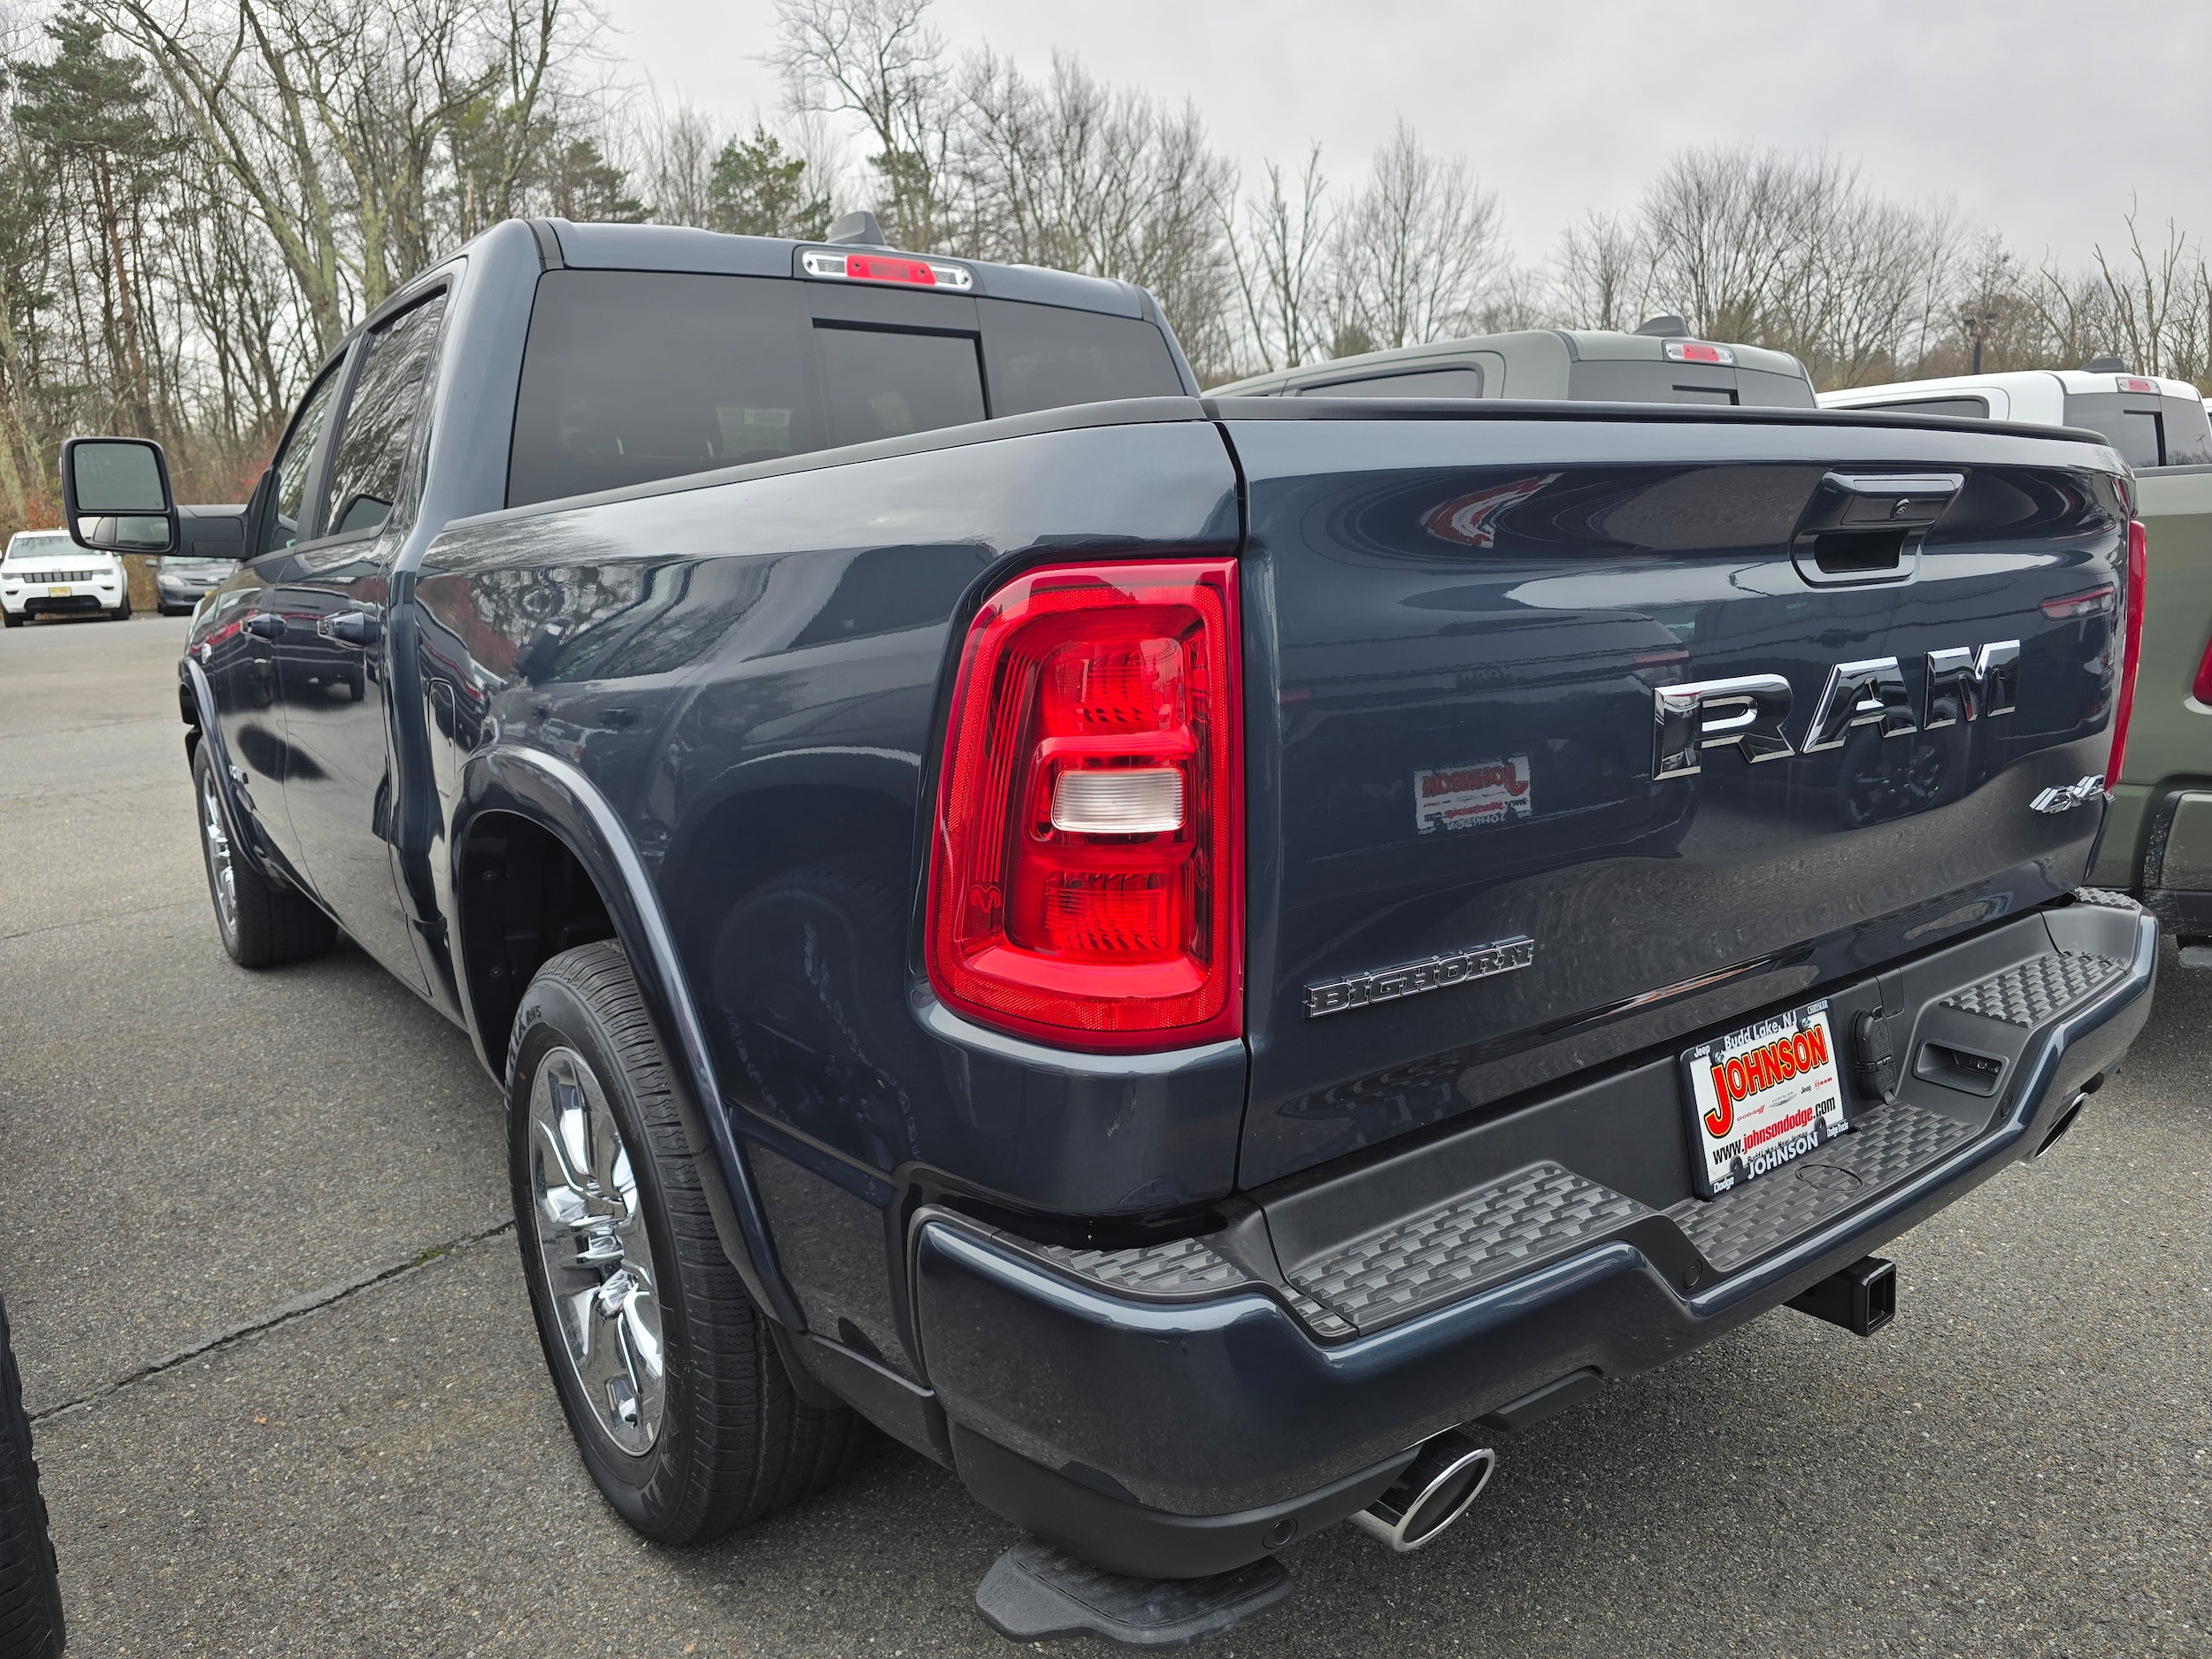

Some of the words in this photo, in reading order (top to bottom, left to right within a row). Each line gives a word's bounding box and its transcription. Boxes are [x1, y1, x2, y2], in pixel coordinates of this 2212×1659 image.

[1653, 639, 2020, 780] RAM
[1302, 934, 1534, 1018] BIGHORN
[1807, 1000, 1829, 1015] CHRYSLER
[1724, 1025, 1751, 1050] Budd
[1782, 1010, 1798, 1029] NJ
[1694, 1044, 1710, 1058] Jeep
[1704, 1024, 1829, 1138] JOHNSON
[1801, 1085, 1812, 1094] Jeep
[1819, 1077, 1832, 1086] RAM
[1737, 1108, 1762, 1122] DODGE
[1713, 1096, 1836, 1164] www.johnsondodge.com
[1747, 1132, 1818, 1179] JOHNSON
[1713, 1177, 1735, 1193] Dodge
